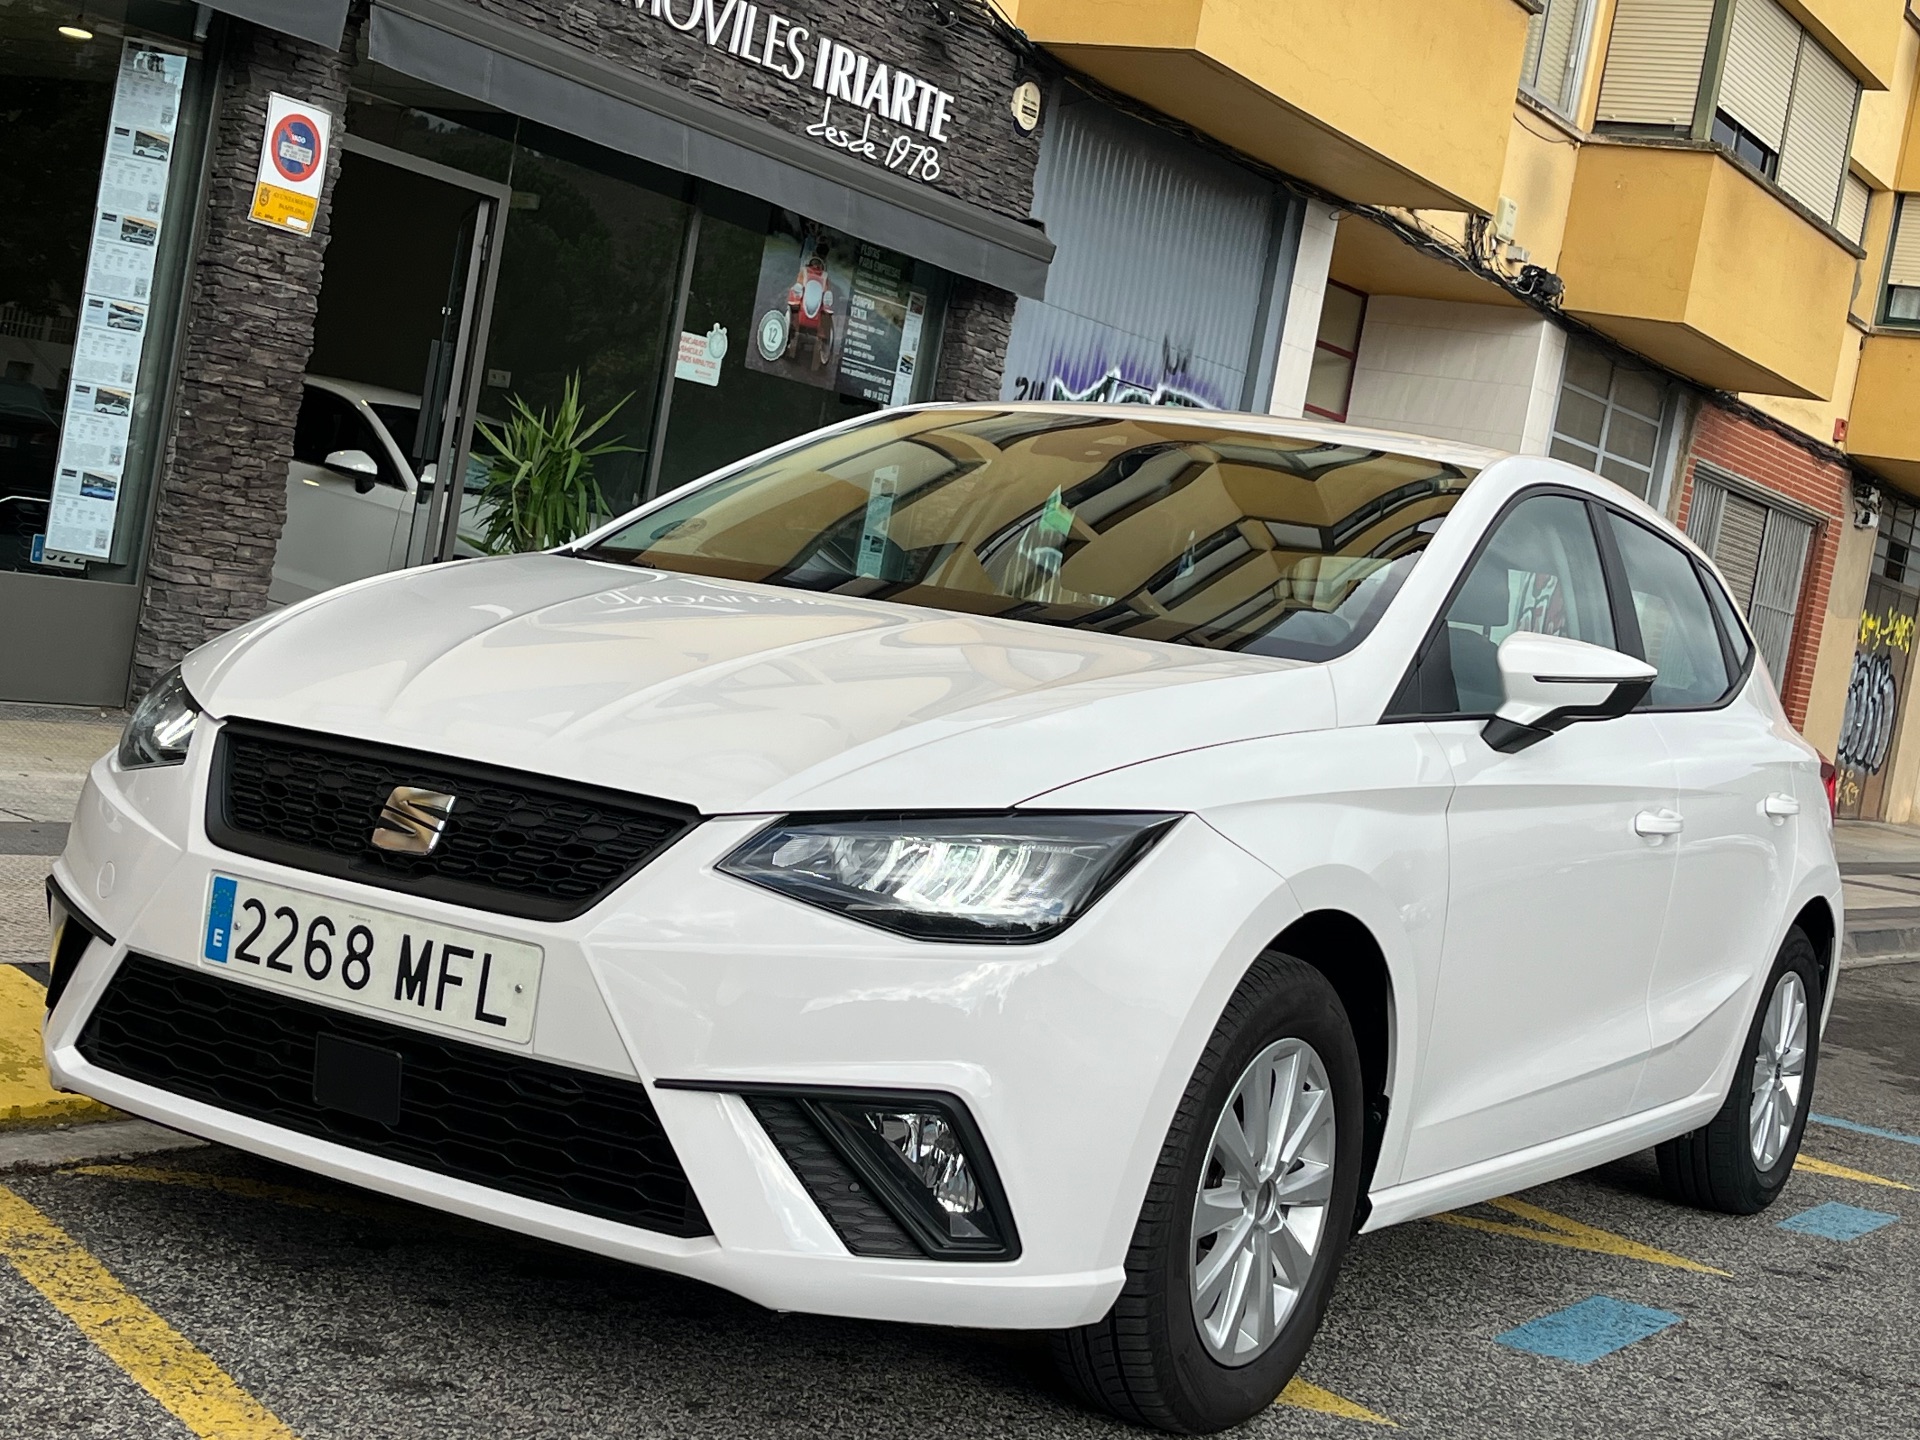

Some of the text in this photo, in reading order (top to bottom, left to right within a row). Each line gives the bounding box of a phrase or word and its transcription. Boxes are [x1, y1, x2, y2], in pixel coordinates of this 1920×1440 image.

[622, 0, 955, 143] OVILES IRIARTE
[806, 97, 941, 181] desde 1978
[213, 897, 508, 1027] E 2268 MFL
